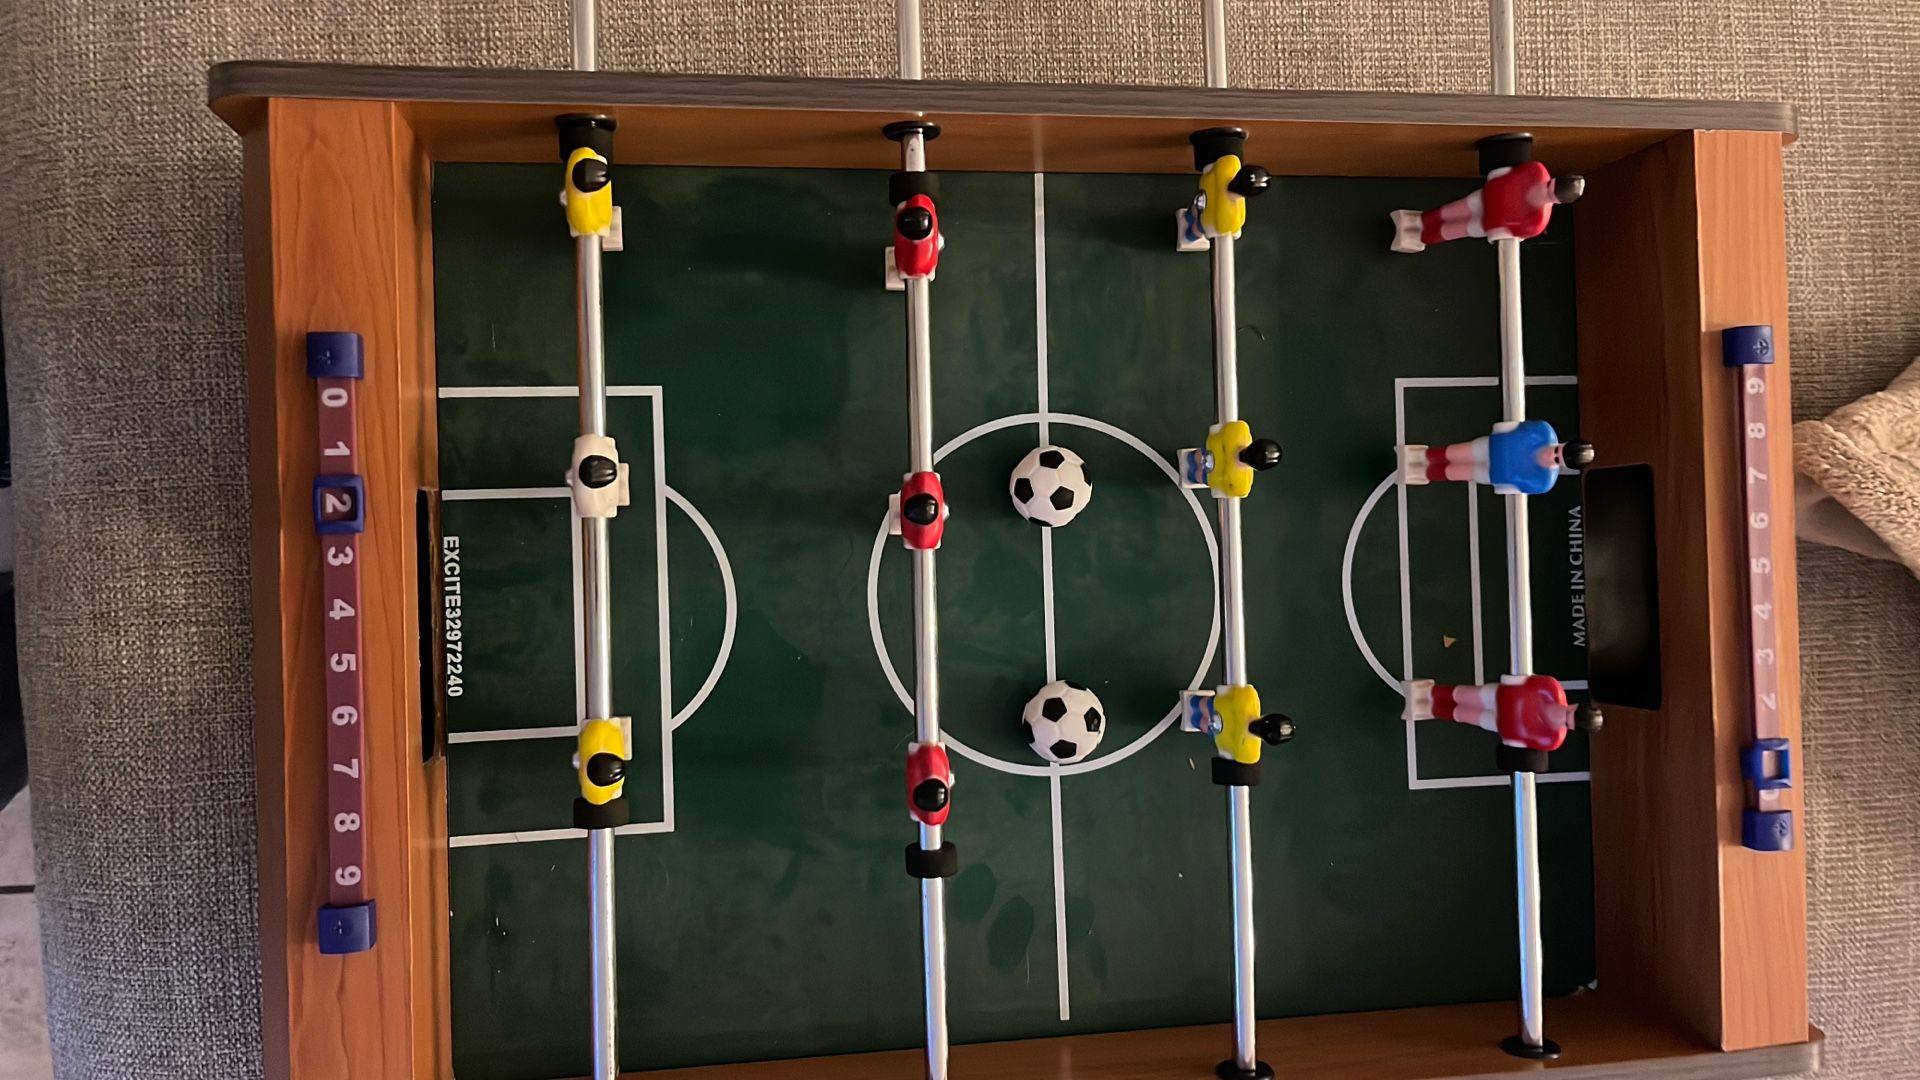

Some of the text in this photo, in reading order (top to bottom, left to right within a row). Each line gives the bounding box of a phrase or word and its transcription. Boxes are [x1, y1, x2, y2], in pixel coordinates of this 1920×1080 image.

[1746, 377, 1765, 394] 9
[1747, 422, 1766, 439] 8
[1748, 467, 1768, 484] 7
[1750, 512, 1769, 529] 6
[1751, 557, 1771, 574] 5
[1568, 505, 1586, 647] MADE IN CHINA
[443, 536, 463, 697] EXCITE32972240
[1753, 602, 1772, 620] 4
[321, 387, 361, 886] 0 1 2 3 4 5 6 7 8 9
[1755, 648, 1774, 665] 3
[1761, 692, 1777, 711] 2
